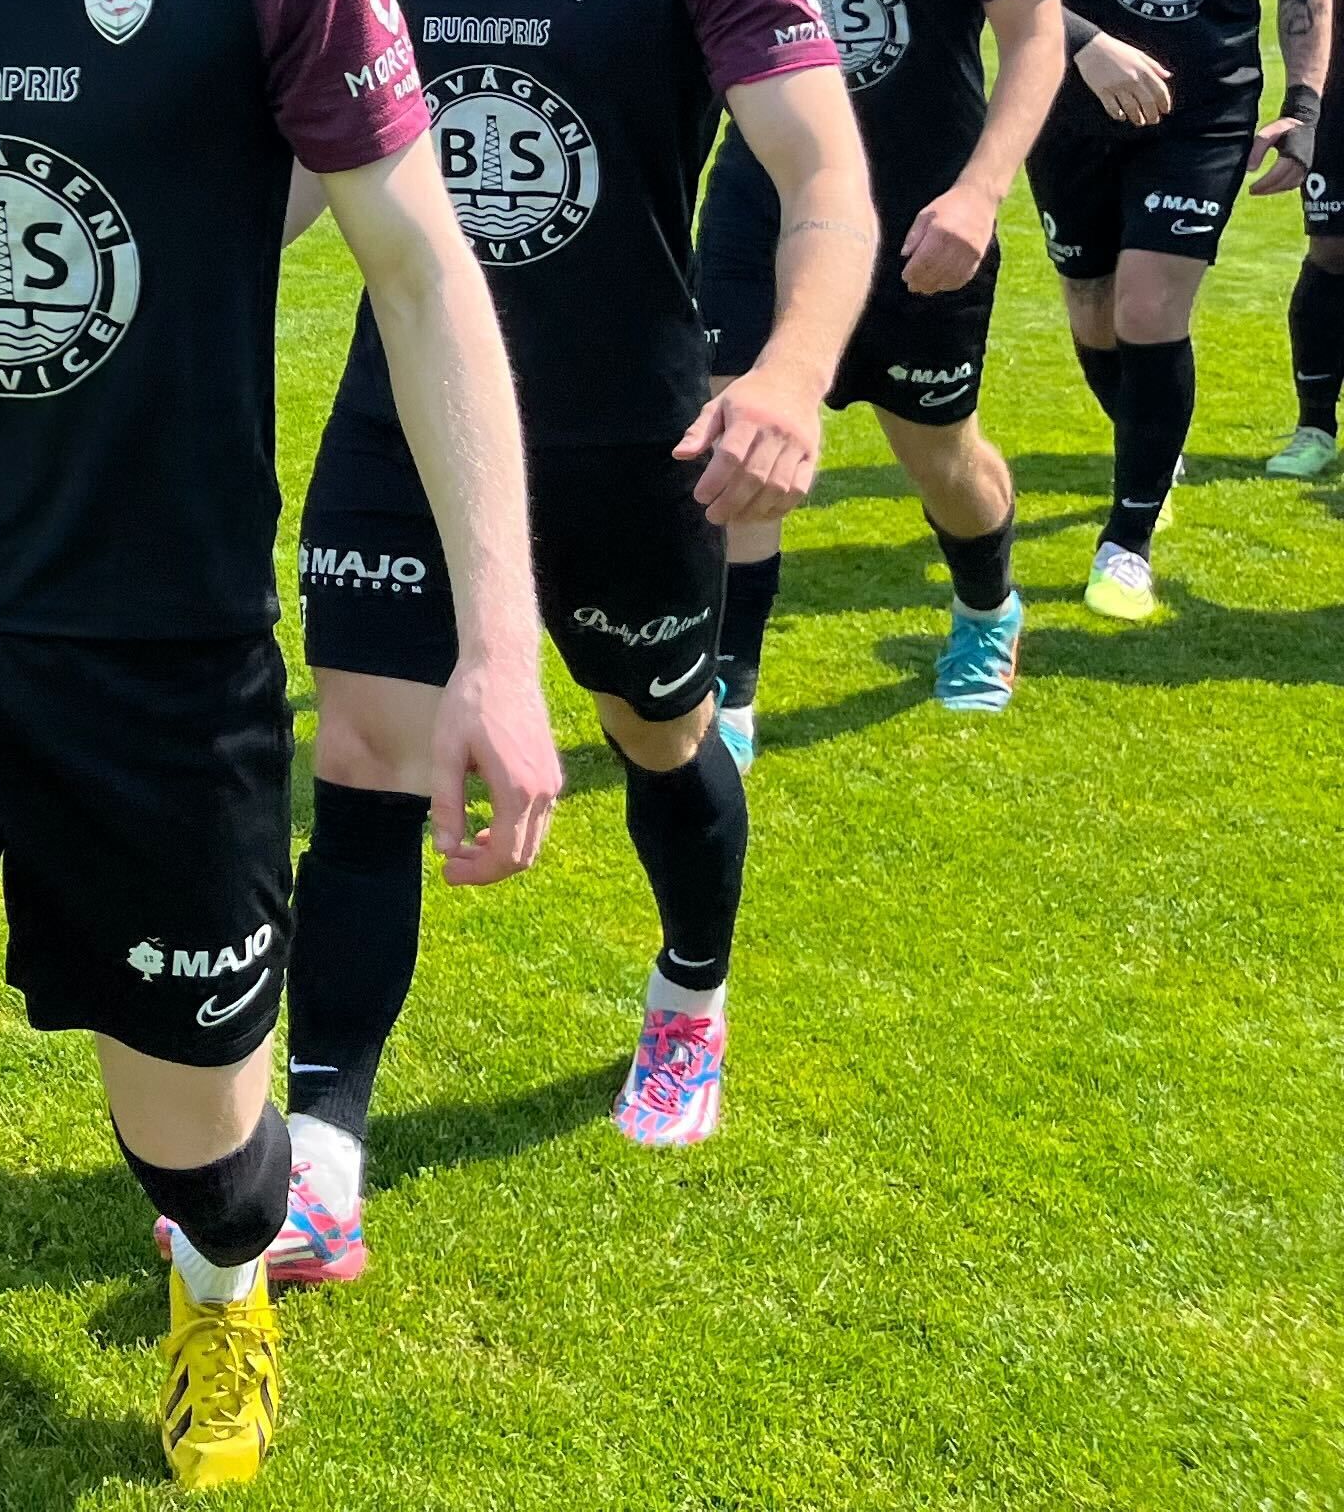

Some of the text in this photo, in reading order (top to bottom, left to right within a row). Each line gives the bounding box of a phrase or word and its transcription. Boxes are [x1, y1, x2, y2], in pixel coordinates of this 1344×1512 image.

[423, 16, 551, 46] BUNNPRIS
[1162, 195, 1220, 217] MAJO
[310, 547, 427, 584] MAJO
[171, 923, 273, 980] MAJO
